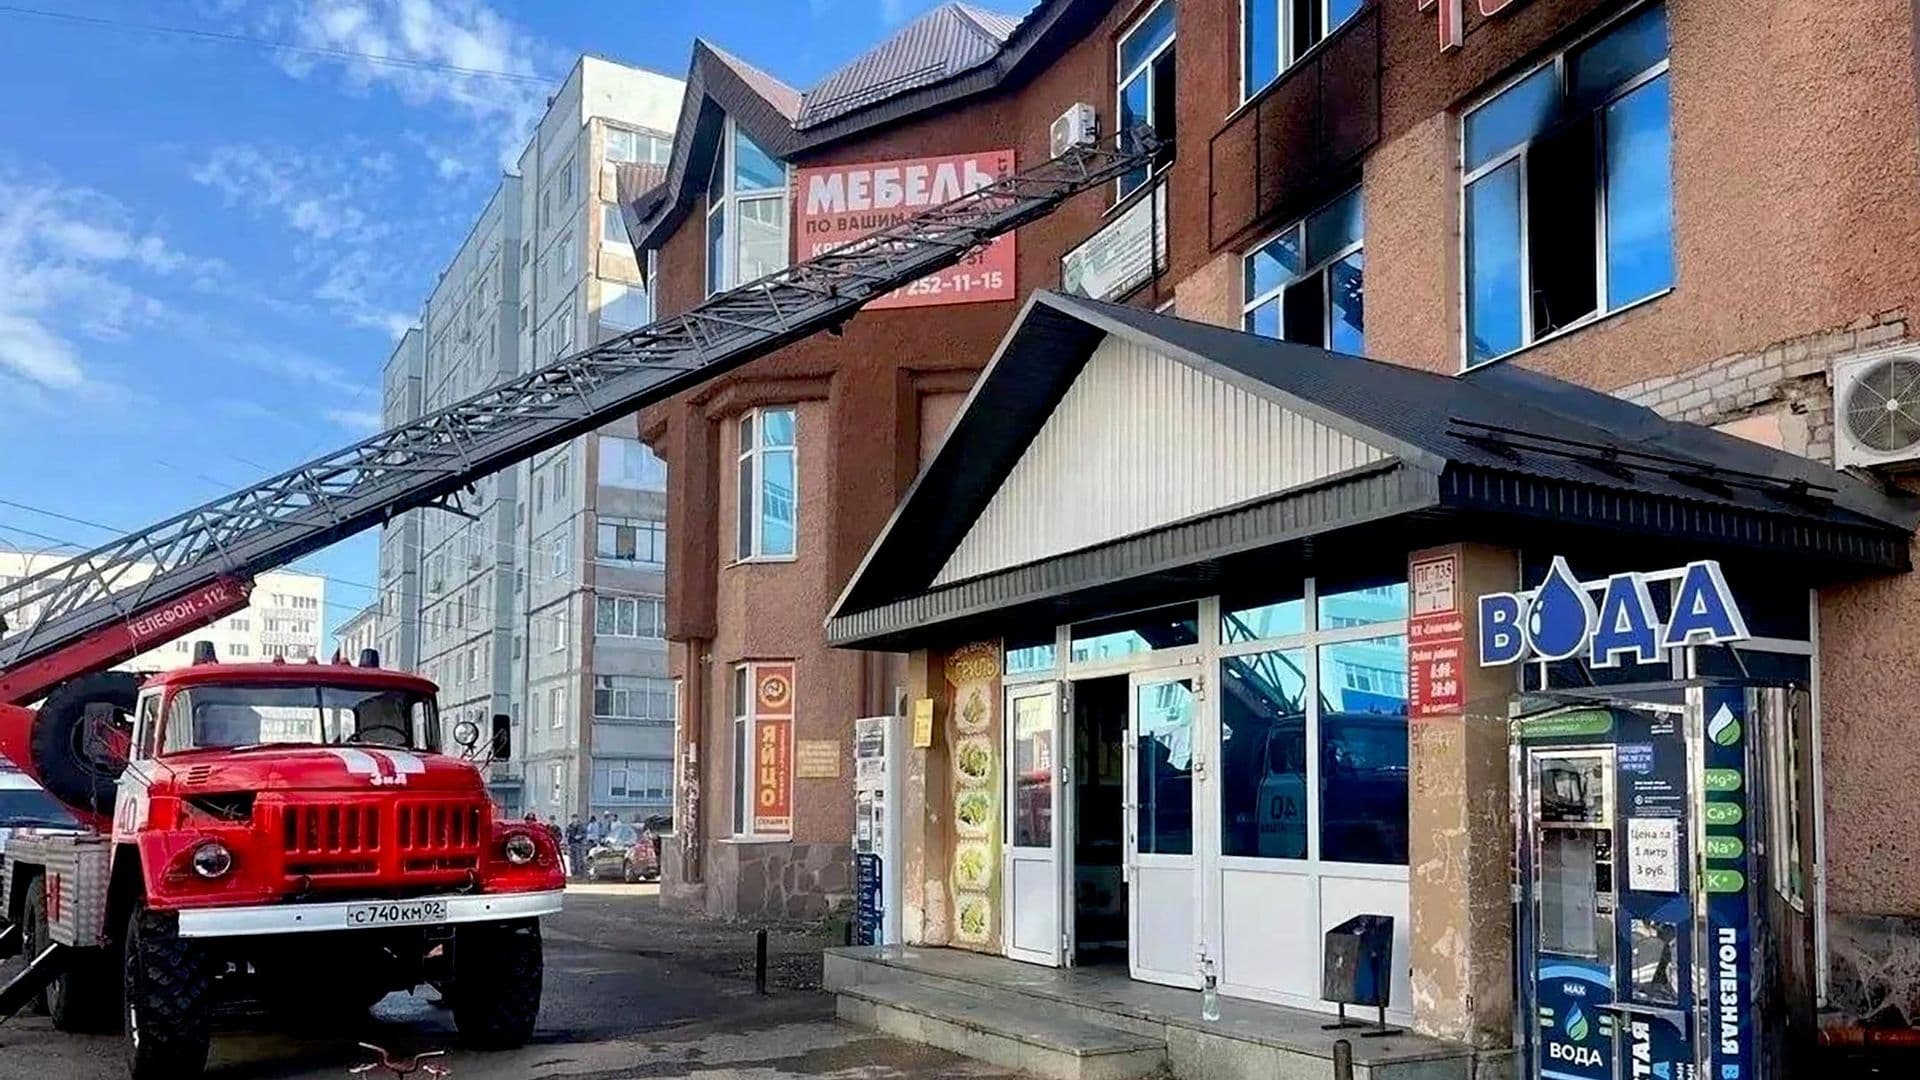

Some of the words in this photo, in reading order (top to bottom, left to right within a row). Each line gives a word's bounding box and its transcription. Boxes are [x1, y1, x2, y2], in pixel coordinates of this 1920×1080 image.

[806, 159, 993, 216] МЕБЕЛЬ
[806, 219, 831, 235] ПО
[837, 212, 905, 231] ВАШИМ
[908, 271, 1003, 295] 252-11-15
[127, 600, 197, 638] ТЕЛЕФОН
[203, 586, 228, 606] 112
[1478, 555, 1750, 668] ВОДА
[760, 725, 777, 807] ЯЙЦО
[1631, 829, 1658, 840] Цена
[1643, 848, 1668, 859] литр
[1637, 864, 1643, 875] 3
[1645, 864, 1668, 877] руб.
[1718, 927, 1740, 1055] ПОЛЕЗНАЯ
[1549, 1042, 1604, 1067] ВОДА
